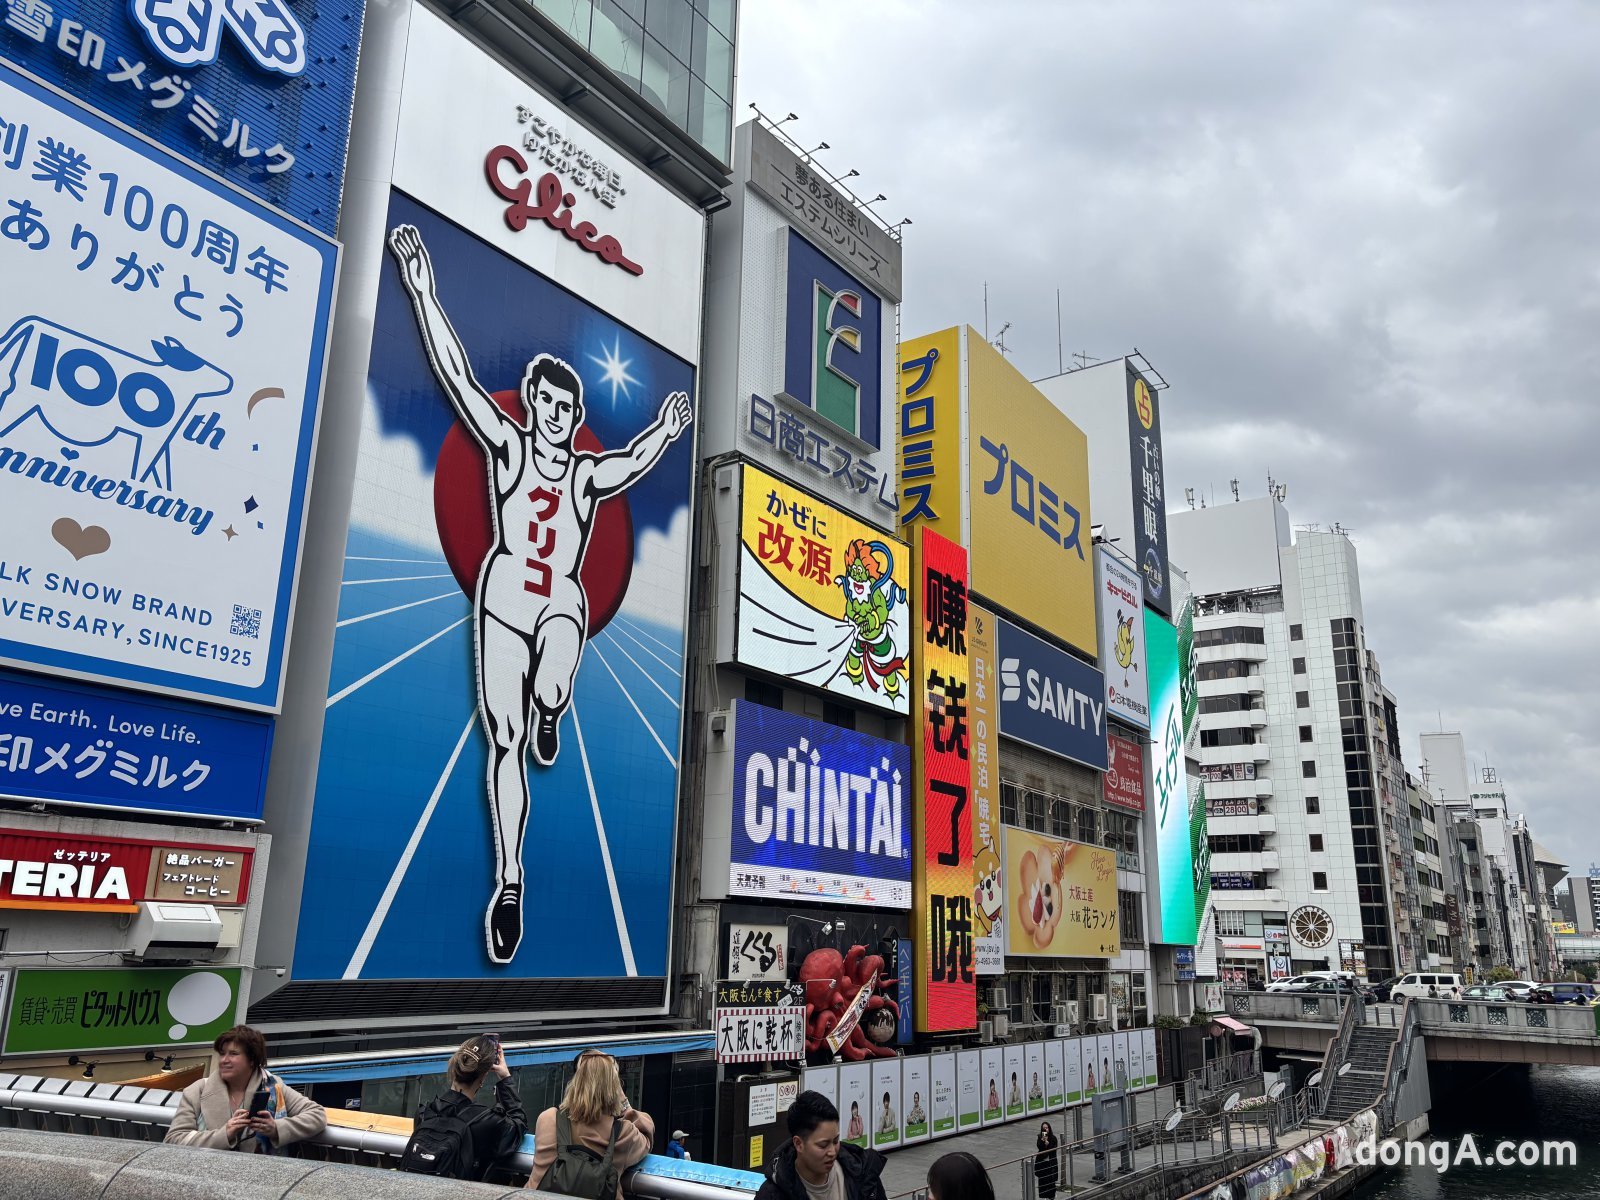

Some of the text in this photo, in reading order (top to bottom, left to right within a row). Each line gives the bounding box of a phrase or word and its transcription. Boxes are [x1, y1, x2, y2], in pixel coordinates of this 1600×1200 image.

[484, 145, 643, 276] Glico
[795, 162, 869, 238] 夢ある住まい
[780, 181, 881, 278] エステムシリーズ
[0, 199, 244, 338] ありがとう
[750, 393, 900, 512] 日商エステム
[901, 347, 940, 525] プロミス
[767, 489, 828, 540] かぜに
[980, 435, 1085, 561] プロミス
[524, 485, 563, 598] グリコ
[758, 516, 834, 587] 改源
[44, 572, 122, 605] SNOW
[131, 593, 213, 627] BRAND
[30, 703, 97, 729] Earth.
[109, 715, 155, 738] Love
[161, 723, 201, 745] Life.
[1027, 668, 1103, 736] SAMTY
[926, 566, 974, 984] 赚钱了哦
[1155, 712, 1182, 806] エイブル
[745, 736, 902, 858] CHINTAI
[1225, 805, 1247, 814] 2800
[54, 849, 111, 863] ゼッテリア
[163, 873, 219, 885] フェアトレード
[166, 853, 235, 868] 絶品バーガー
[737, 873, 766, 889] 天気予報
[185, 885, 231, 898] コーヒー
[1069, 885, 1094, 902] 大阪土産
[1082, 906, 1116, 930] 花ラング
[740, 930, 777, 972] くくる
[892, 939, 898, 968] 2F
[19, 988, 160, 1028] 賃貸・売買 ピタットハウス
[794, 996, 804, 1006] 2F
[720, 1016, 793, 1053] 大阪に乾杯
